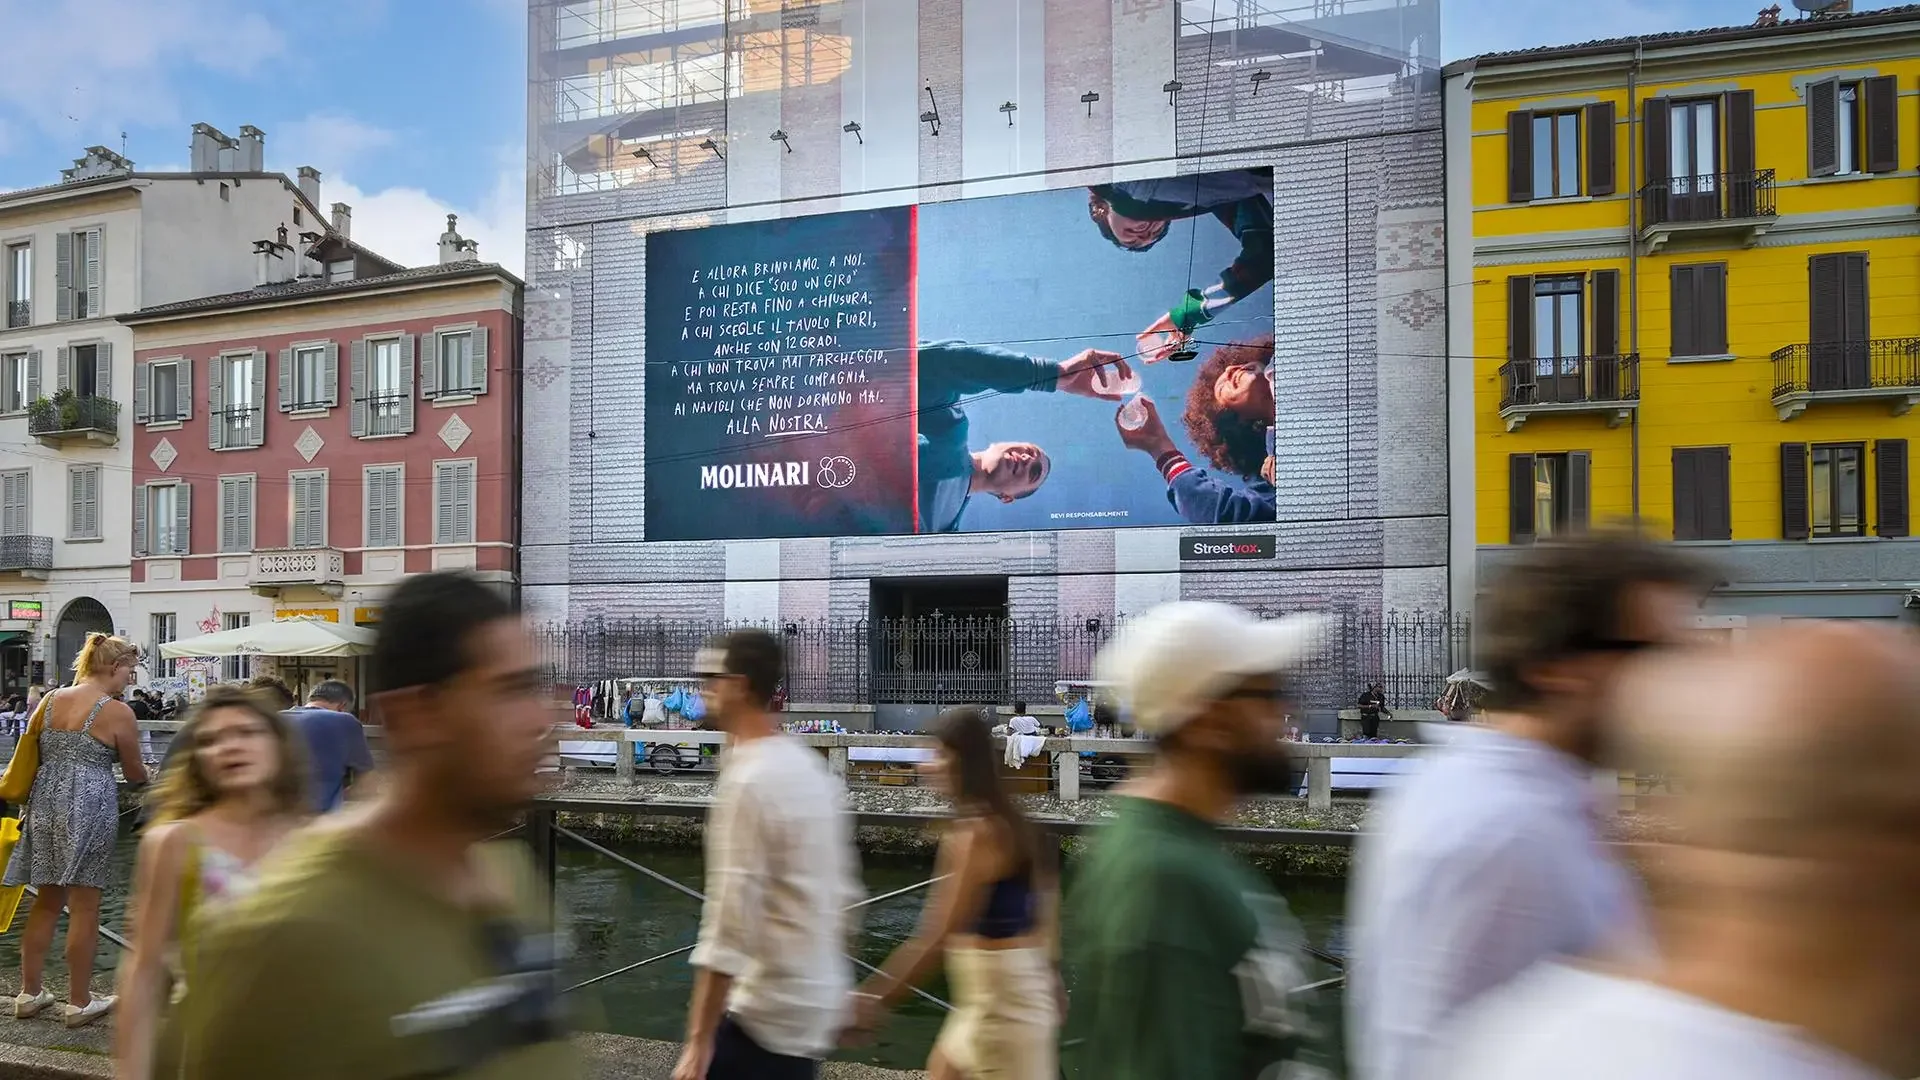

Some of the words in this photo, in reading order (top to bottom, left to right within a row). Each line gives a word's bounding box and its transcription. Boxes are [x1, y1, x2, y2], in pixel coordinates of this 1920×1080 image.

[692, 270, 699, 283] E
[707, 265, 747, 279] ALLORA
[754, 258, 819, 274] BRINDIAMO.
[829, 257, 835, 266] A
[843, 253, 865, 266] NOI.
[699, 287, 705, 299] A
[712, 284, 729, 297] CHI
[737, 281, 762, 296] DICE
[805, 277, 819, 289] UN
[685, 307, 691, 321] E
[700, 305, 715, 319] POI
[724, 302, 757, 317] RESTA
[765, 299, 791, 313] FINO
[798, 299, 803, 307] A
[812, 292, 872, 308] CHIUSURA.
[682, 328, 688, 340] A
[695, 326, 712, 339] CHI
[720, 321, 764, 336] SCEGLIE
[772, 321, 782, 333] IL
[786, 318, 829, 333] TAVOLO
[836, 312, 876, 328] FUORI,
[714, 341, 750, 357] ANCHE
[758, 340, 780, 353] CON
[786, 336, 796, 349] 12
[800, 335, 840, 348] GRADI.
[672, 366, 677, 376] A
[684, 363, 701, 376] CHI
[708, 361, 729, 374] NON
[736, 358, 775, 372] TROVA
[783, 354, 801, 369] MAI
[810, 349, 887, 365] PARCHEGGIO,
[688, 383, 702, 394] MA
[709, 380, 745, 393] TROVA
[752, 375, 795, 391] SEMPRE
[804, 371, 869, 385] COMPAGNIA.
[675, 403, 685, 415] AI
[693, 400, 734, 414] NAVIGLI
[741, 398, 762, 412] CHE
[769, 396, 791, 409] NON
[798, 392, 851, 407] DORMONO
[859, 390, 883, 404] MAI.
[726, 419, 760, 434] ALLA
[770, 414, 828, 430] NOSTRA.
[701, 462, 809, 489] MOLINARI
[1193, 543, 1261, 554] Streetvox.
